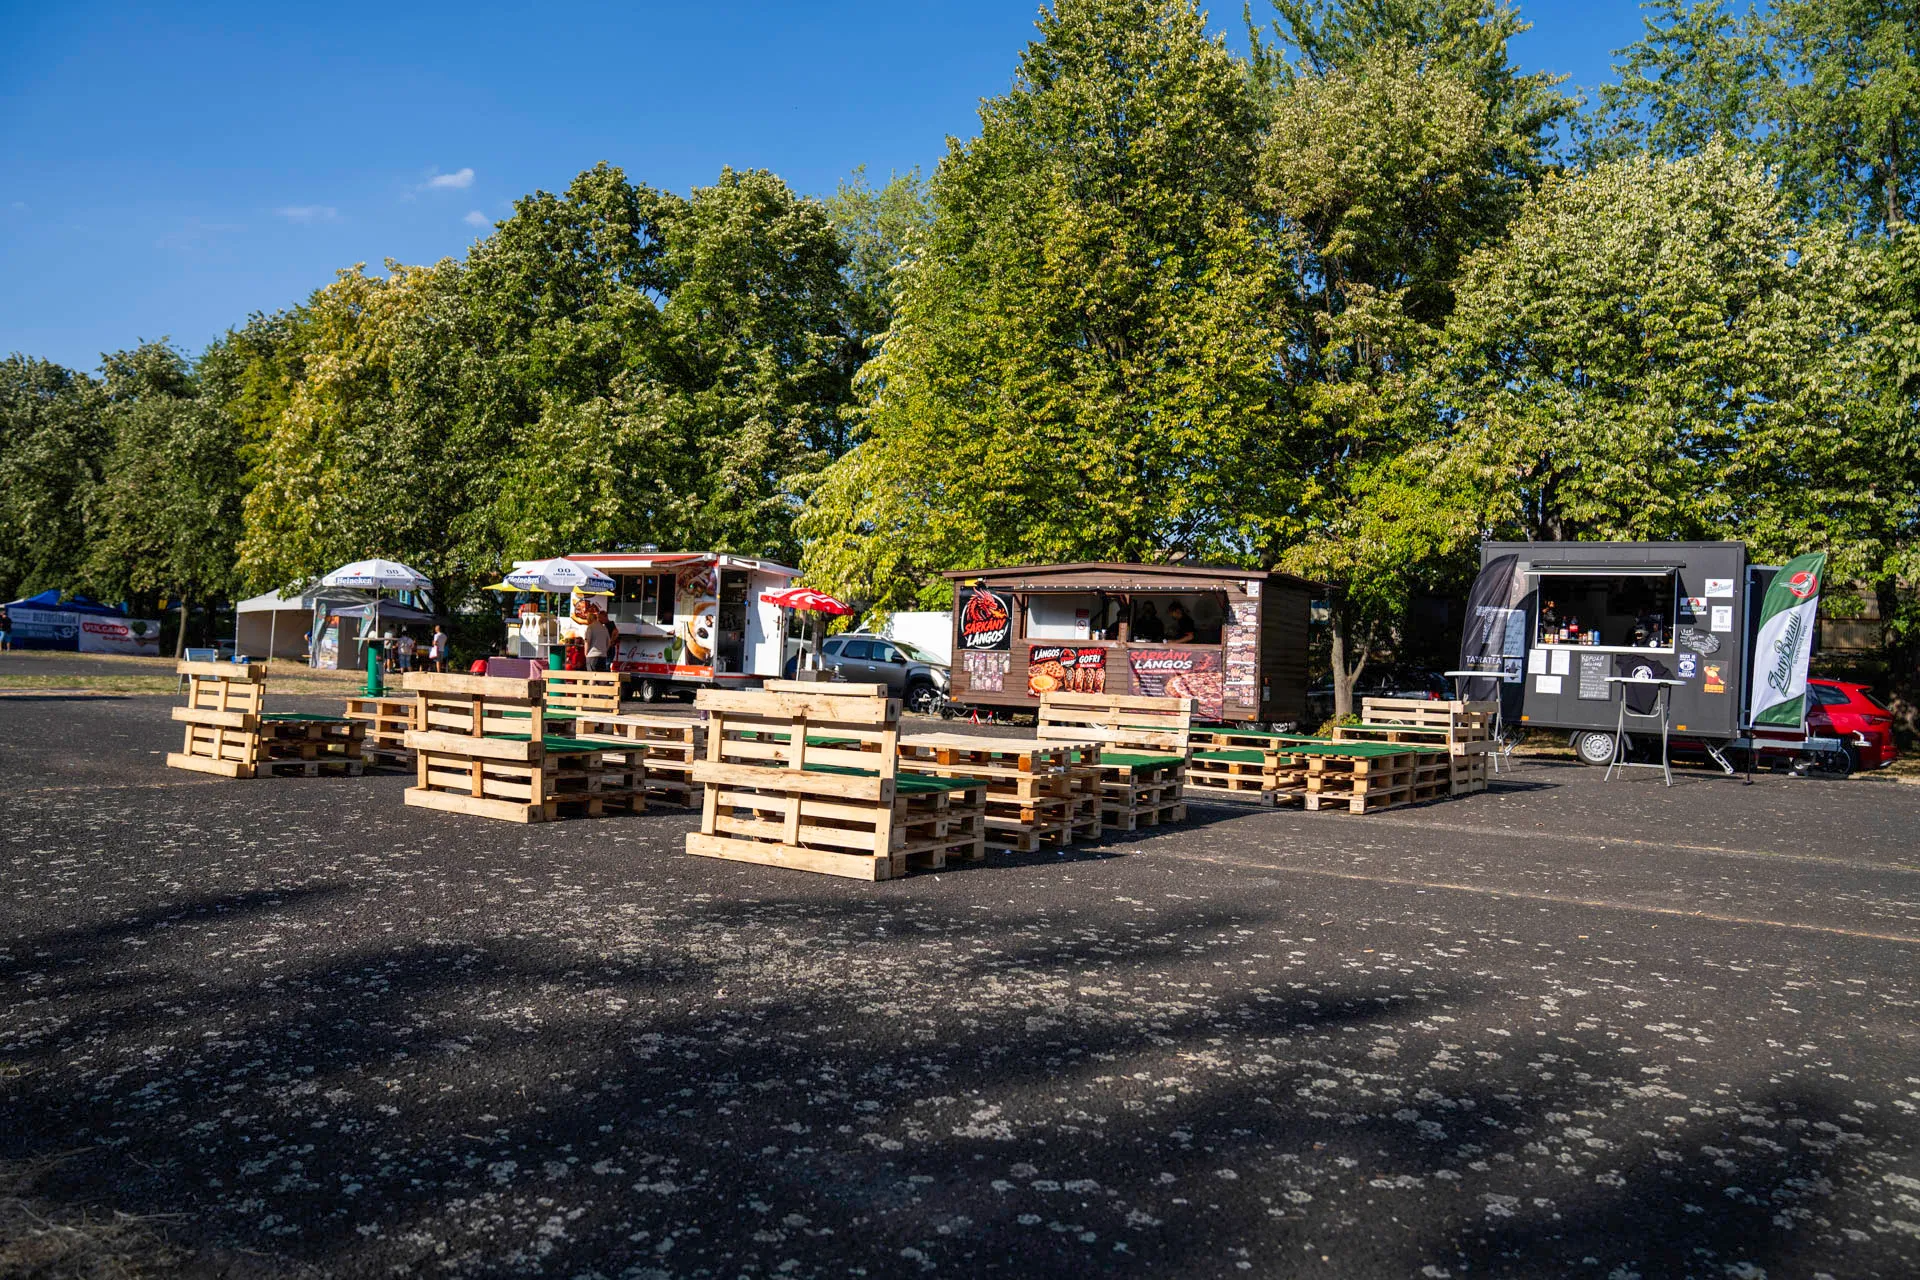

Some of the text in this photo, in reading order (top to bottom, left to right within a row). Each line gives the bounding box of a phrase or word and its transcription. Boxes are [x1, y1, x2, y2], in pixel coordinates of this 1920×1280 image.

[336, 576, 373, 585] Heineken
[507, 575, 541, 585] Heineken
[84, 623, 128, 635] VULCANO
[963, 617, 1006, 636] SÁRKÁNY
[967, 629, 1005, 647] LÁNGOS
[1034, 647, 1061, 661] LÁNGOS
[1078, 655, 1101, 663] GOFRI
[1130, 650, 1192, 661] SÁRKÁNY
[1768, 612, 1802, 698] Zlatý Bažant
[1134, 659, 1193, 669] LÁNGOS
